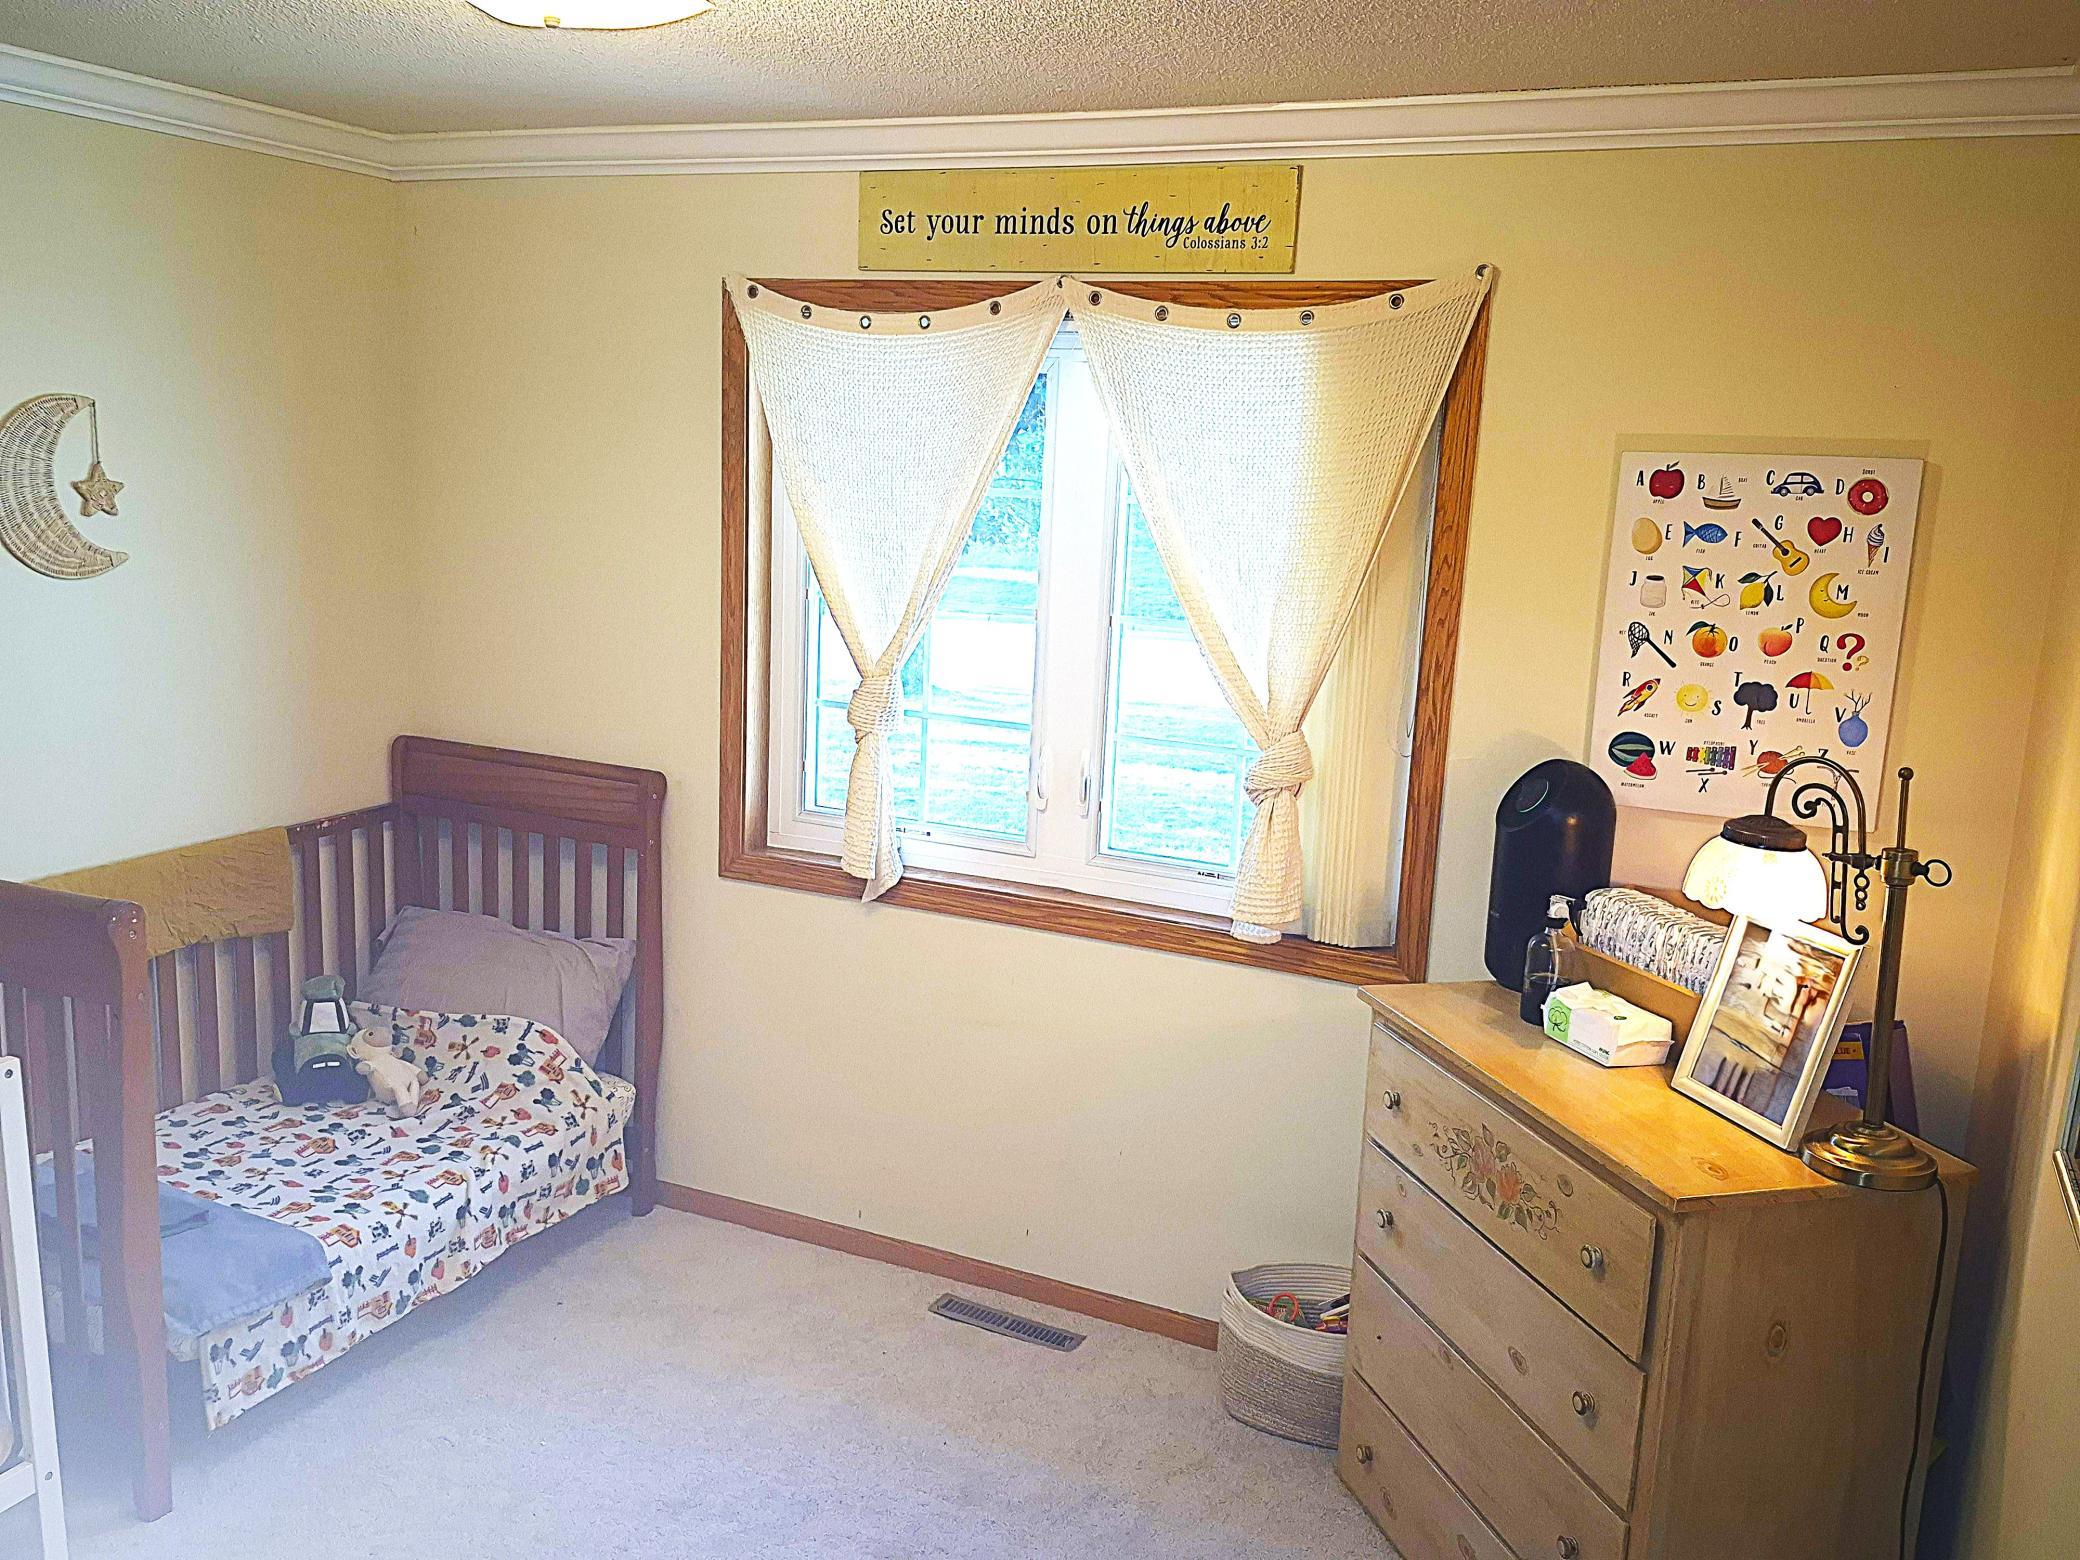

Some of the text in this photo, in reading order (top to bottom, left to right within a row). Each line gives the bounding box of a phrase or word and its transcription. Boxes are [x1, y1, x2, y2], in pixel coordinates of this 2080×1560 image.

[879, 201, 1272, 248] Set your minds on things above
[1183, 236, 1270, 250] Colossians 3:2
[1636, 470, 1644, 487] A
[1697, 473, 1706, 490] B
[1765, 469, 1776, 486] C
[1835, 478, 1845, 496] D
[1774, 515, 1784, 531] G
[1665, 523, 1673, 540] E
[1734, 531, 1742, 548] F
[1842, 526, 1854, 543] H
[1883, 546, 1890, 563] I
[1629, 570, 1637, 586] J
[1715, 573, 1725, 589] K
[1776, 584, 1784, 601] L
[1836, 584, 1849, 601] M
[1795, 617, 1805, 634] P
[1663, 629, 1673, 645] N
[1728, 636, 1739, 652] O
[1819, 634, 1830, 654] Q
[1622, 671, 1631, 687] R
[1734, 671, 1743, 687] T
[1711, 700, 1722, 716] S
[1789, 693, 1800, 709] U
[1835, 706, 1847, 723] V
[1659, 740, 1676, 756] W
[1749, 739, 1759, 755] Y
[1698, 777, 1709, 793] X
[1834, 1047, 1851, 1055] LUE
